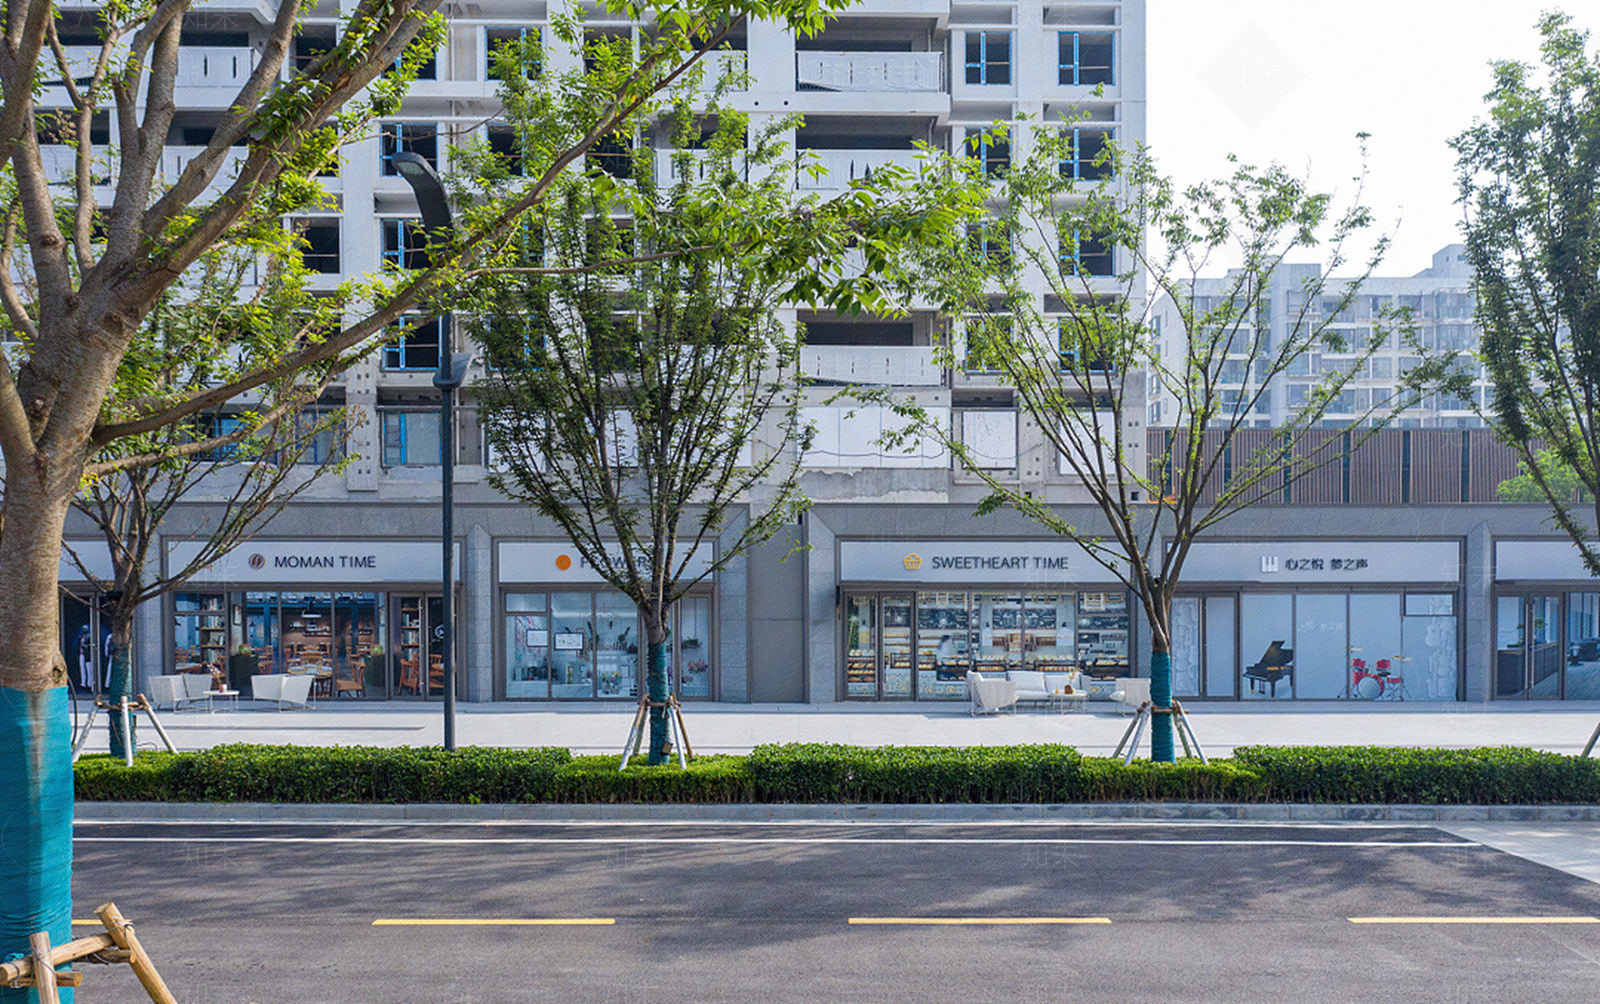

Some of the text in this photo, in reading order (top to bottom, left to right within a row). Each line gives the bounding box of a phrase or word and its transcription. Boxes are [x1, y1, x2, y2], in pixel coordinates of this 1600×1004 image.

[274, 555, 376, 568] MOMAN TIME
[932, 556, 1069, 569] SWEETHEART TIME
[1285, 558, 1368, 570] 心之悦 梦之声
